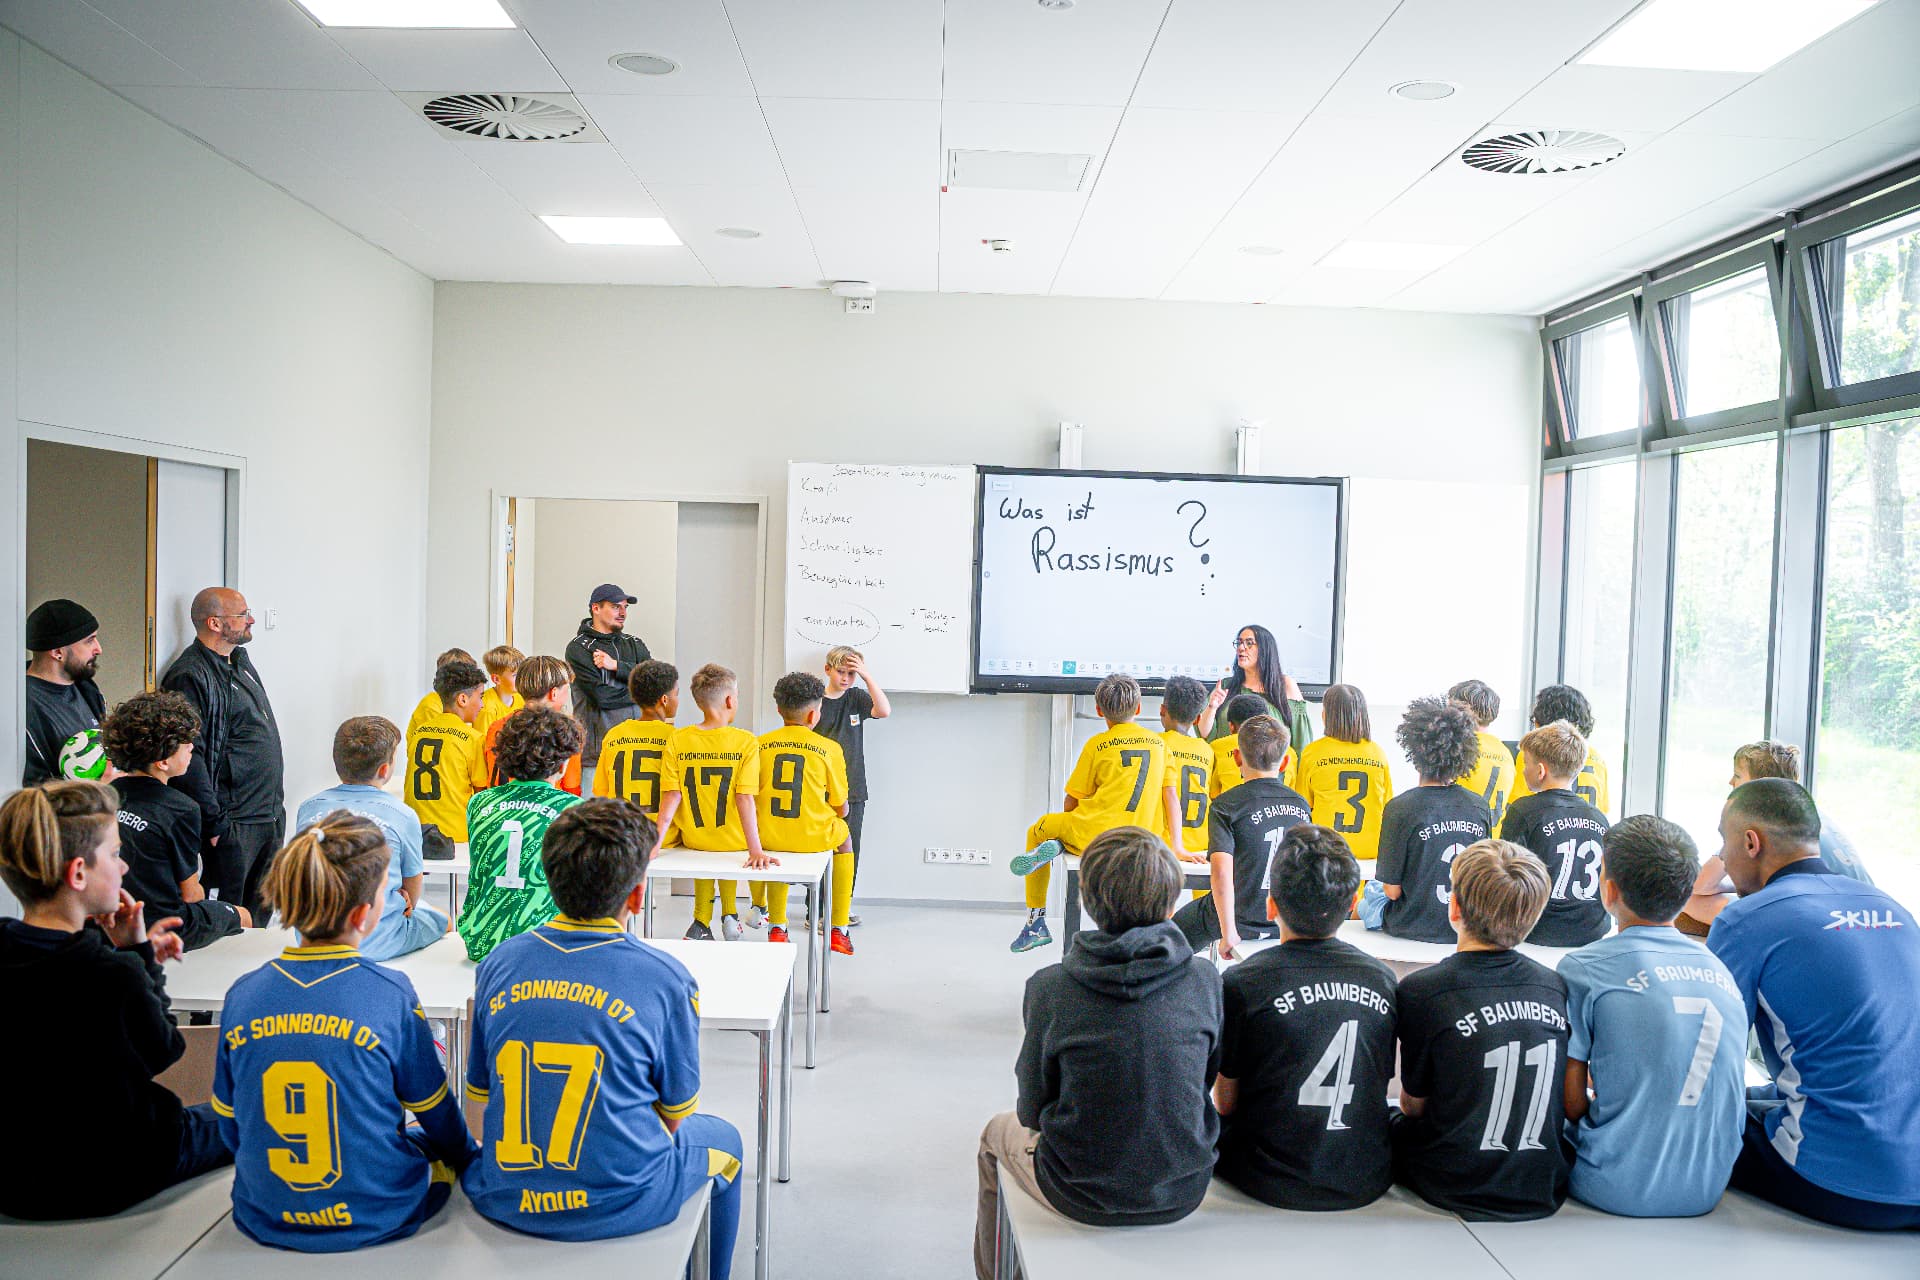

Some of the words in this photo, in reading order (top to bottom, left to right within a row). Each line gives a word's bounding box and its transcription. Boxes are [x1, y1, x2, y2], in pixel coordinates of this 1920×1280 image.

[999, 497, 1044, 520] Was
[1067, 491, 1095, 521] ist
[1031, 525, 1174, 577] Rassismus
[414, 738, 443, 800] 8
[613, 750, 662, 813] 15
[684, 767, 733, 828] 17
[771, 753, 805, 818] 9
[1120, 750, 1151, 812] 7
[1180, 765, 1208, 828] 6
[117, 810, 148, 831] BERG
[480, 805, 495, 817] SF
[499, 800, 561, 819] BAUMBER
[1251, 810, 1264, 825] SF
[1334, 771, 1368, 833] 3
[1418, 827, 1432, 841] SF
[1432, 820, 1484, 837] BAUMBERG
[1542, 822, 1556, 837] SF
[1556, 817, 1607, 836] BAUMBERG
[495, 820, 525, 889] 1
[1260, 826, 1285, 890] 1
[1551, 838, 1604, 901] 13
[1822, 909, 1905, 930] SKILL
[489, 991, 506, 1016] SC
[510, 979, 609, 1010] SONNBORN
[606, 998, 636, 1024] 07
[1273, 990, 1297, 1015] SF
[1299, 982, 1390, 1015] BAUMBERG
[1626, 970, 1650, 993] SF
[225, 1025, 247, 1051] SC
[250, 1013, 354, 1040] SONNBORN
[353, 1025, 381, 1051] 07
[1455, 1012, 1479, 1037] SF
[1672, 996, 1724, 1106] 7
[495, 1039, 605, 1171] 17
[1297, 1019, 1358, 1130] 4
[1479, 1038, 1557, 1151] 11
[262, 1060, 342, 1192] 9
